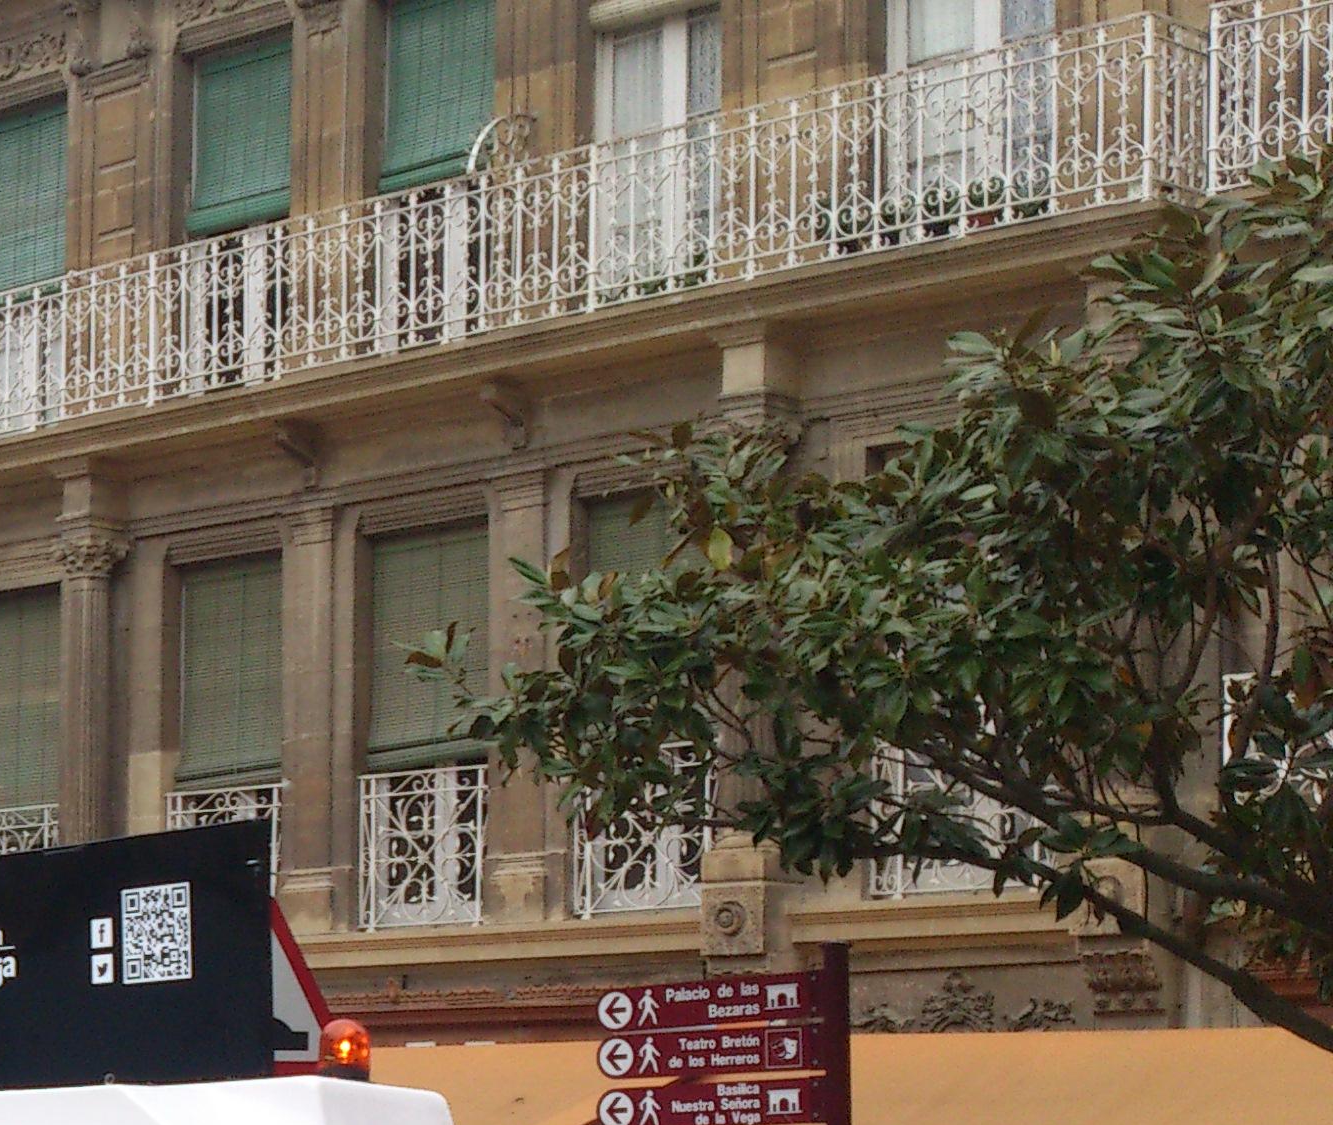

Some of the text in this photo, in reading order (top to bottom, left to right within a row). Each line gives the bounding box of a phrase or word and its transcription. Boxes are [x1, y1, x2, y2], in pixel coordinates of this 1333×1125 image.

[665, 982, 760, 1003] Palacio de las
[707, 1003, 761, 1019] Bezaras
[678, 1034, 760, 1052] Teatro Bretón
[668, 1053, 761, 1069] de los Herreros
[671, 1097, 761, 1113] Nuestra Señora
[695, 1111, 761, 1125] de la Vega
